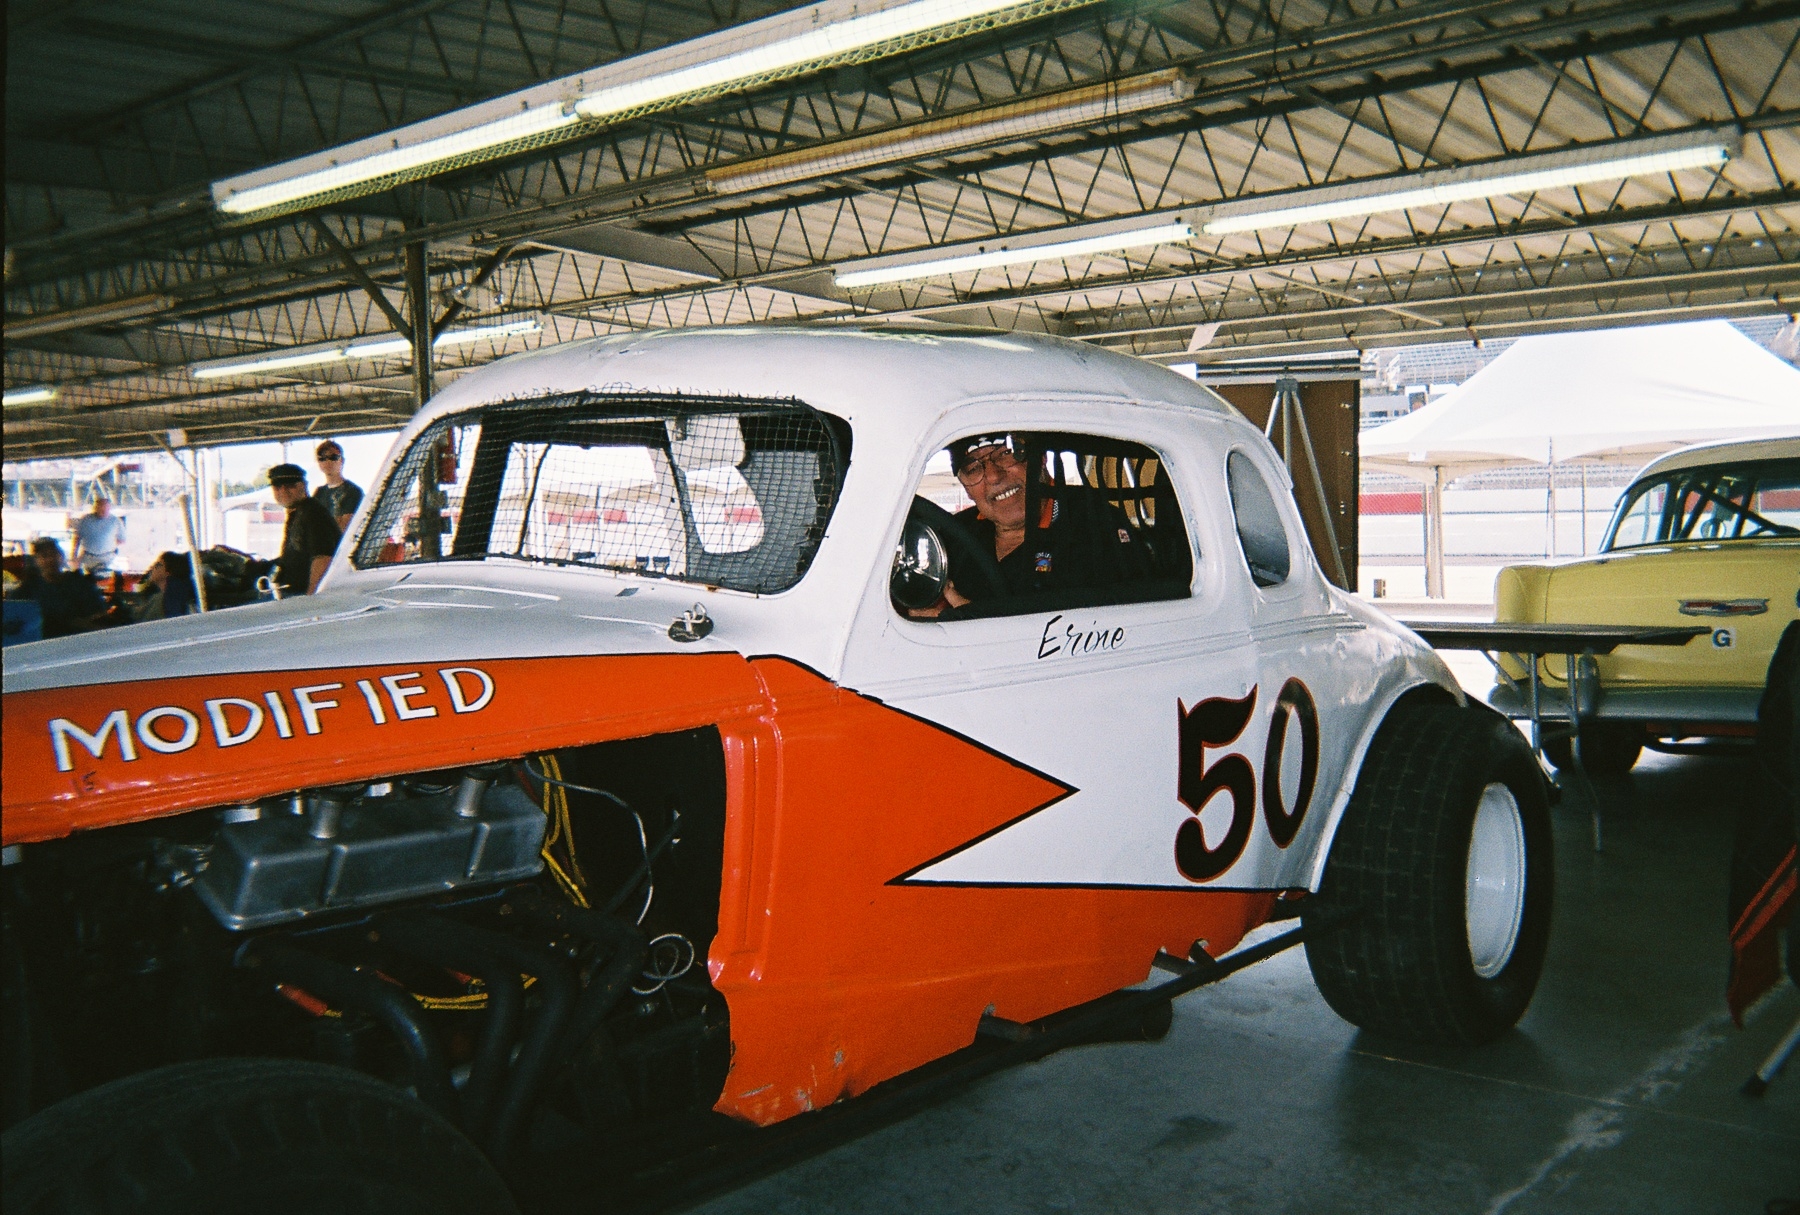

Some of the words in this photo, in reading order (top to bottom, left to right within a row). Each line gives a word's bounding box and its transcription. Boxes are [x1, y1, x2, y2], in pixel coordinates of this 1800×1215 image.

[1038, 614, 1126, 659] Erine
[1712, 628, 1731, 648] G
[49, 667, 495, 772] MODIFIED
[1174, 677, 1320, 883] 50
